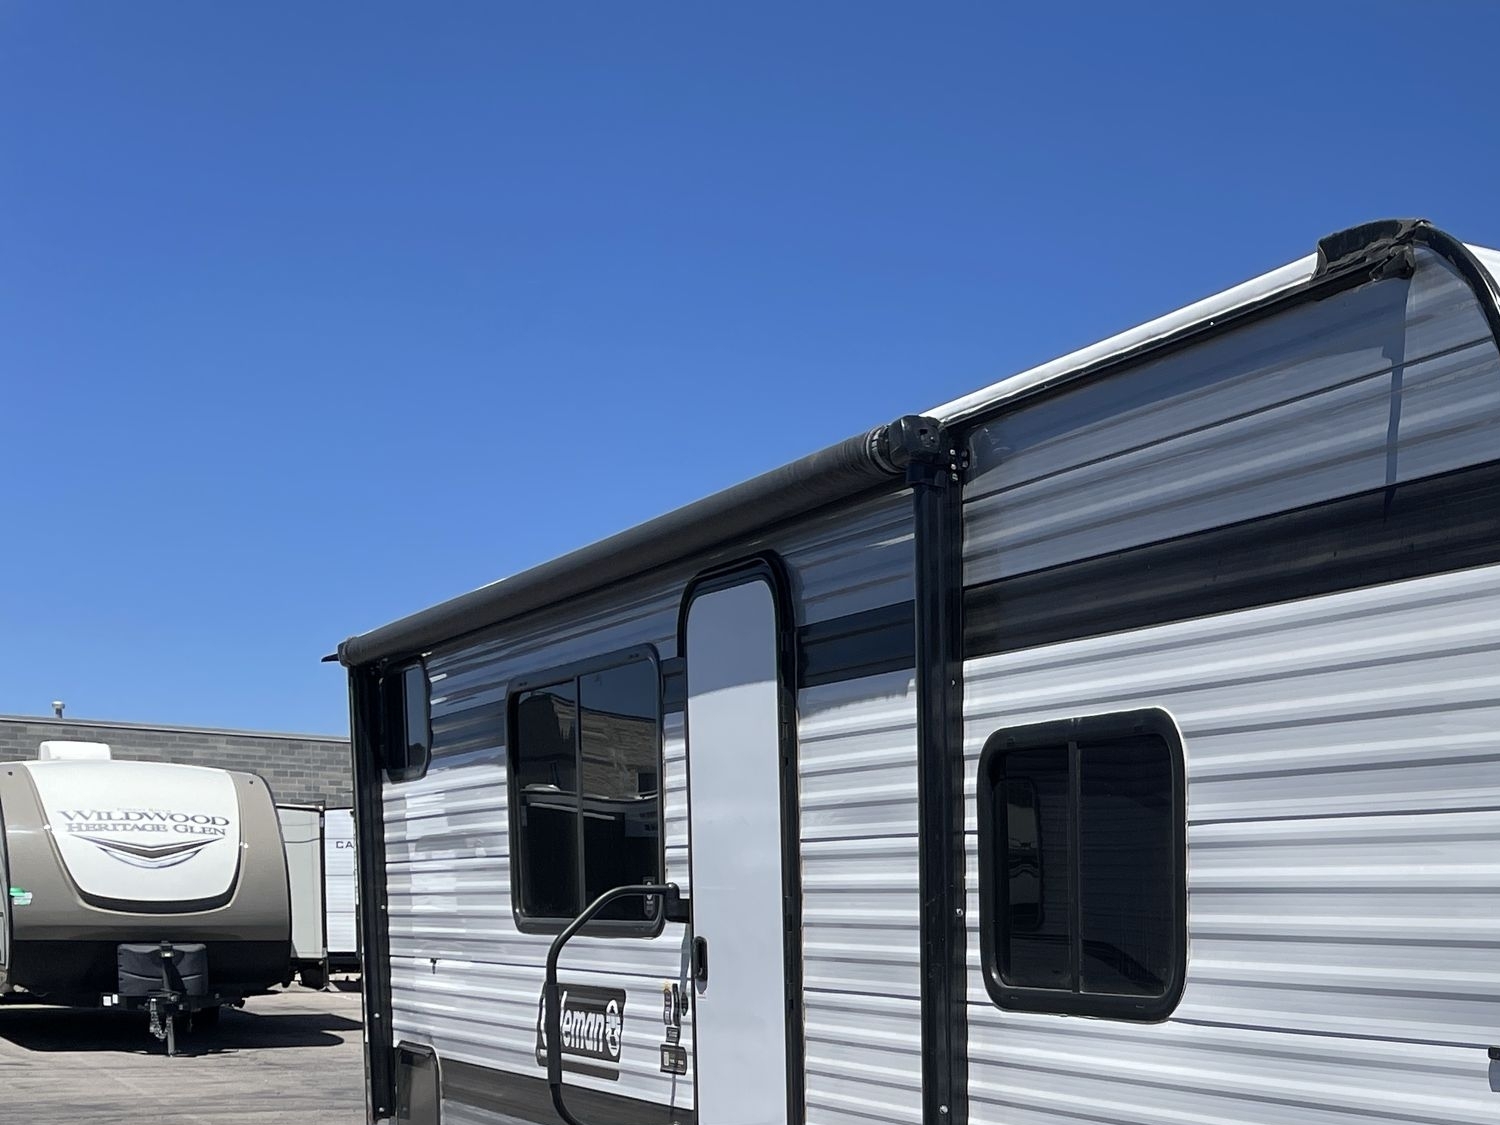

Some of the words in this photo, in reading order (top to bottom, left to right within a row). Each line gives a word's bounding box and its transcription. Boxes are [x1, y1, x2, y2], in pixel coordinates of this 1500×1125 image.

[57, 810, 230, 827] WILDWOOD
[65, 822, 168, 833] HERITAGE
[173, 824, 227, 836] GLEN
[541, 990, 605, 1053] leman
